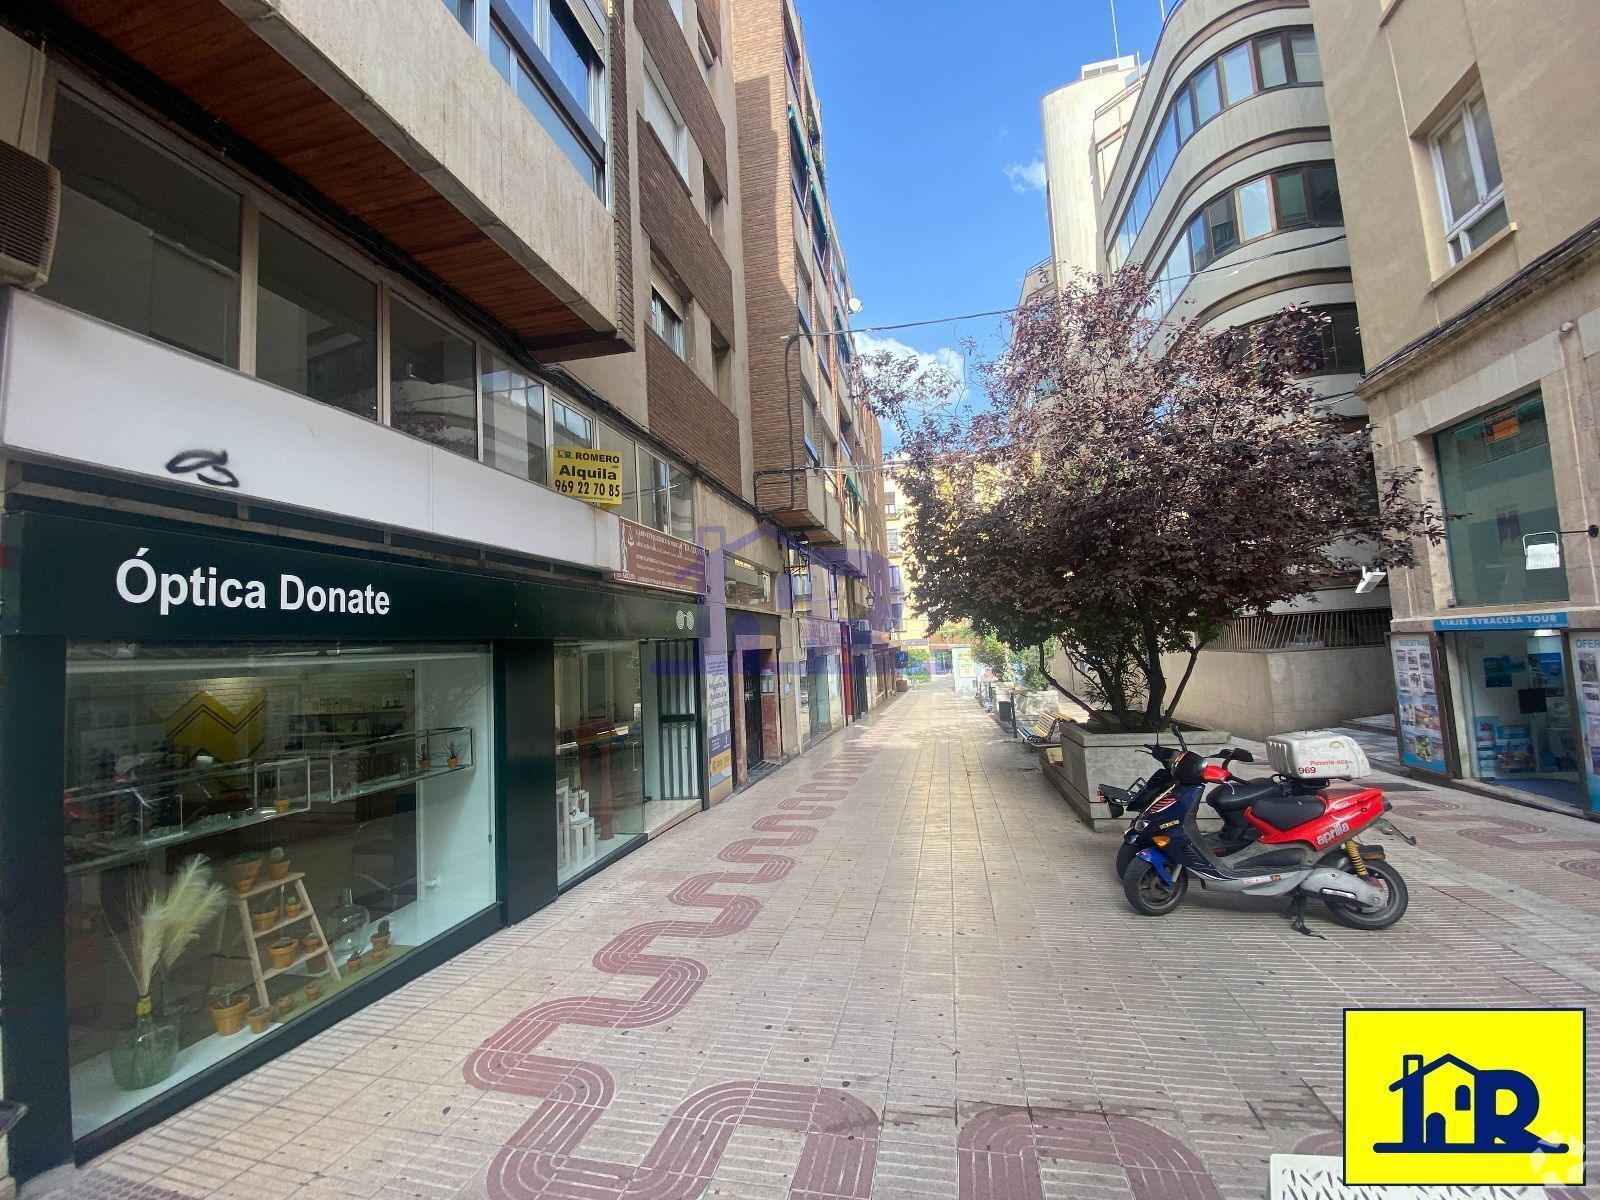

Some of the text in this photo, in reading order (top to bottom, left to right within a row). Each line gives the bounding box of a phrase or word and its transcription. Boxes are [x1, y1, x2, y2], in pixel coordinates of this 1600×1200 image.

[575, 451, 620, 464] ROMERO
[559, 464, 617, 480] Alquila
[555, 479, 620, 497] 969 22 70 85
[116, 547, 390, 616] Óptica Donate
[1440, 613, 1557, 626] VIAJES SYRACUSA TOUR
[1298, 766, 1317, 775] 969
[1316, 821, 1350, 846] aprilia
